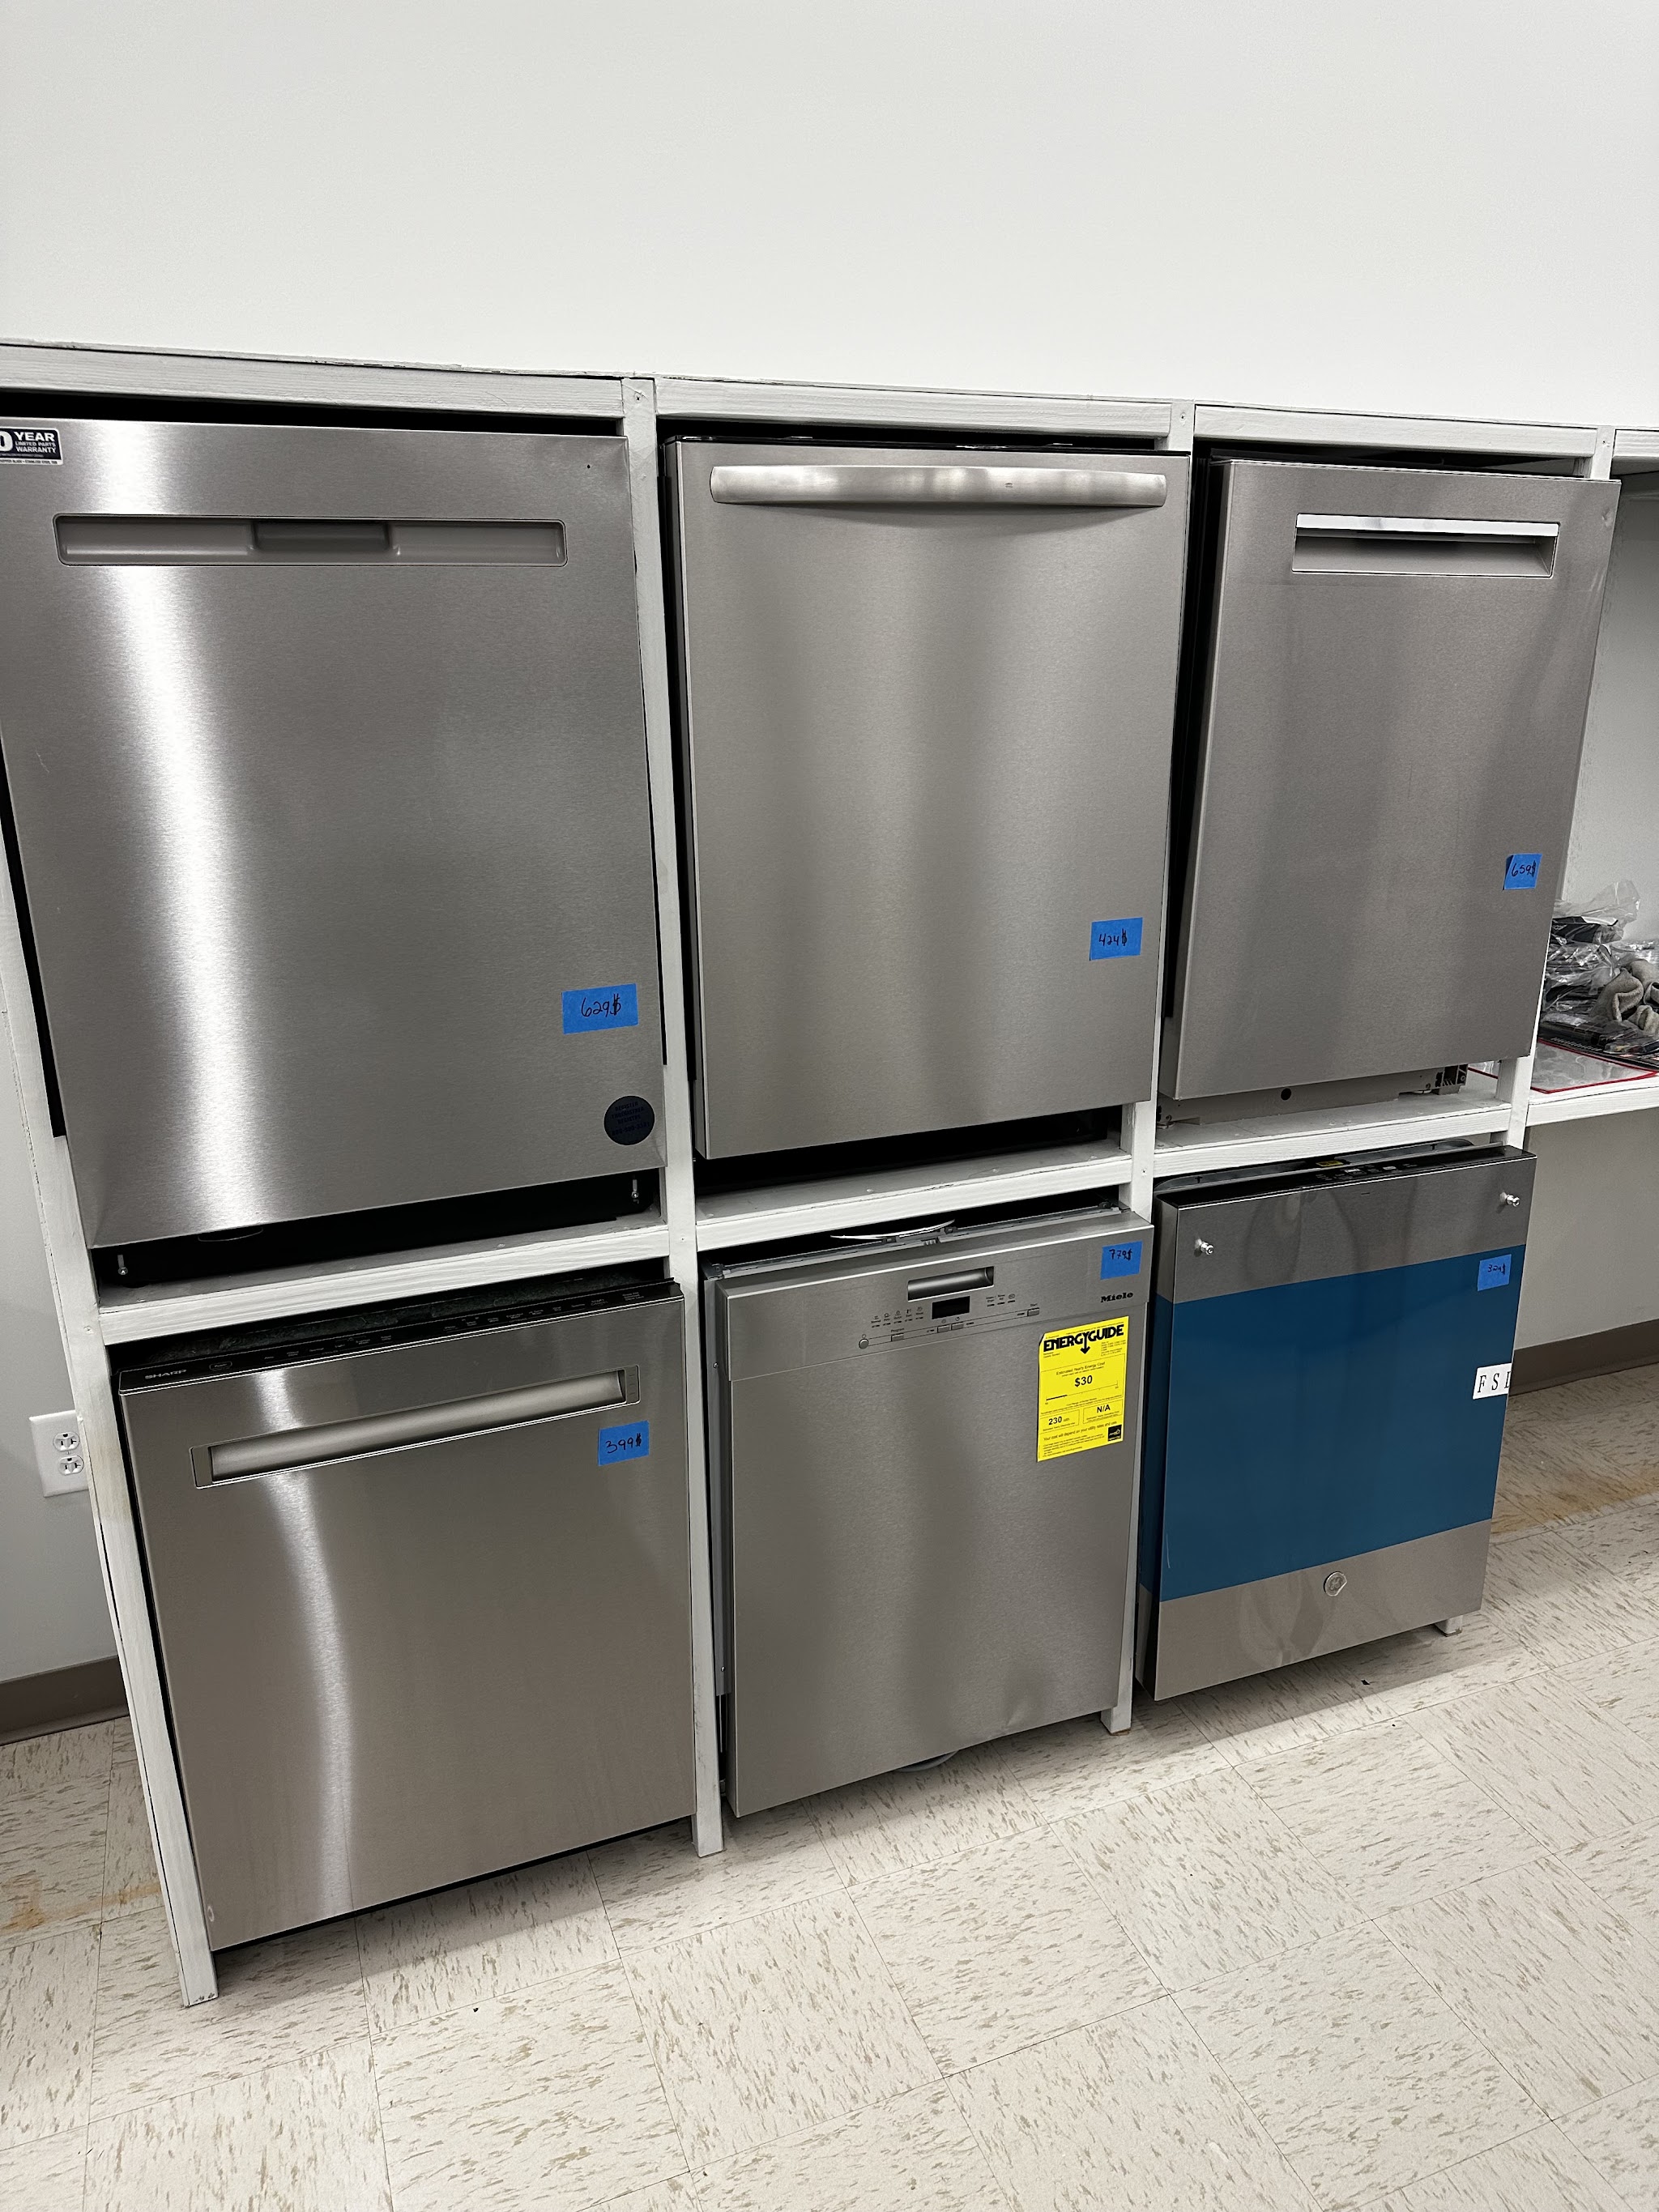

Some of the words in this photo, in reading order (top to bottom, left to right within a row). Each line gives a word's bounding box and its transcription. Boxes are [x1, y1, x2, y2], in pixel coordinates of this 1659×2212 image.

[14, 432, 55, 441] YEAR
[1511, 859, 1537, 878] 659$
[1098, 928, 1128, 947] 424$
[581, 993, 621, 1017] 629$
[1100, 1292, 1134, 1302] Miele
[1043, 1324, 1124, 1352] ENERGYGUIDE
[145, 1369, 186, 1379] SHARP
[1074, 1375, 1093, 1387] $30
[1096, 1404, 1111, 1413] N/A
[1048, 1416, 1062, 1426] 230
[605, 1432, 642, 1454] 399$
